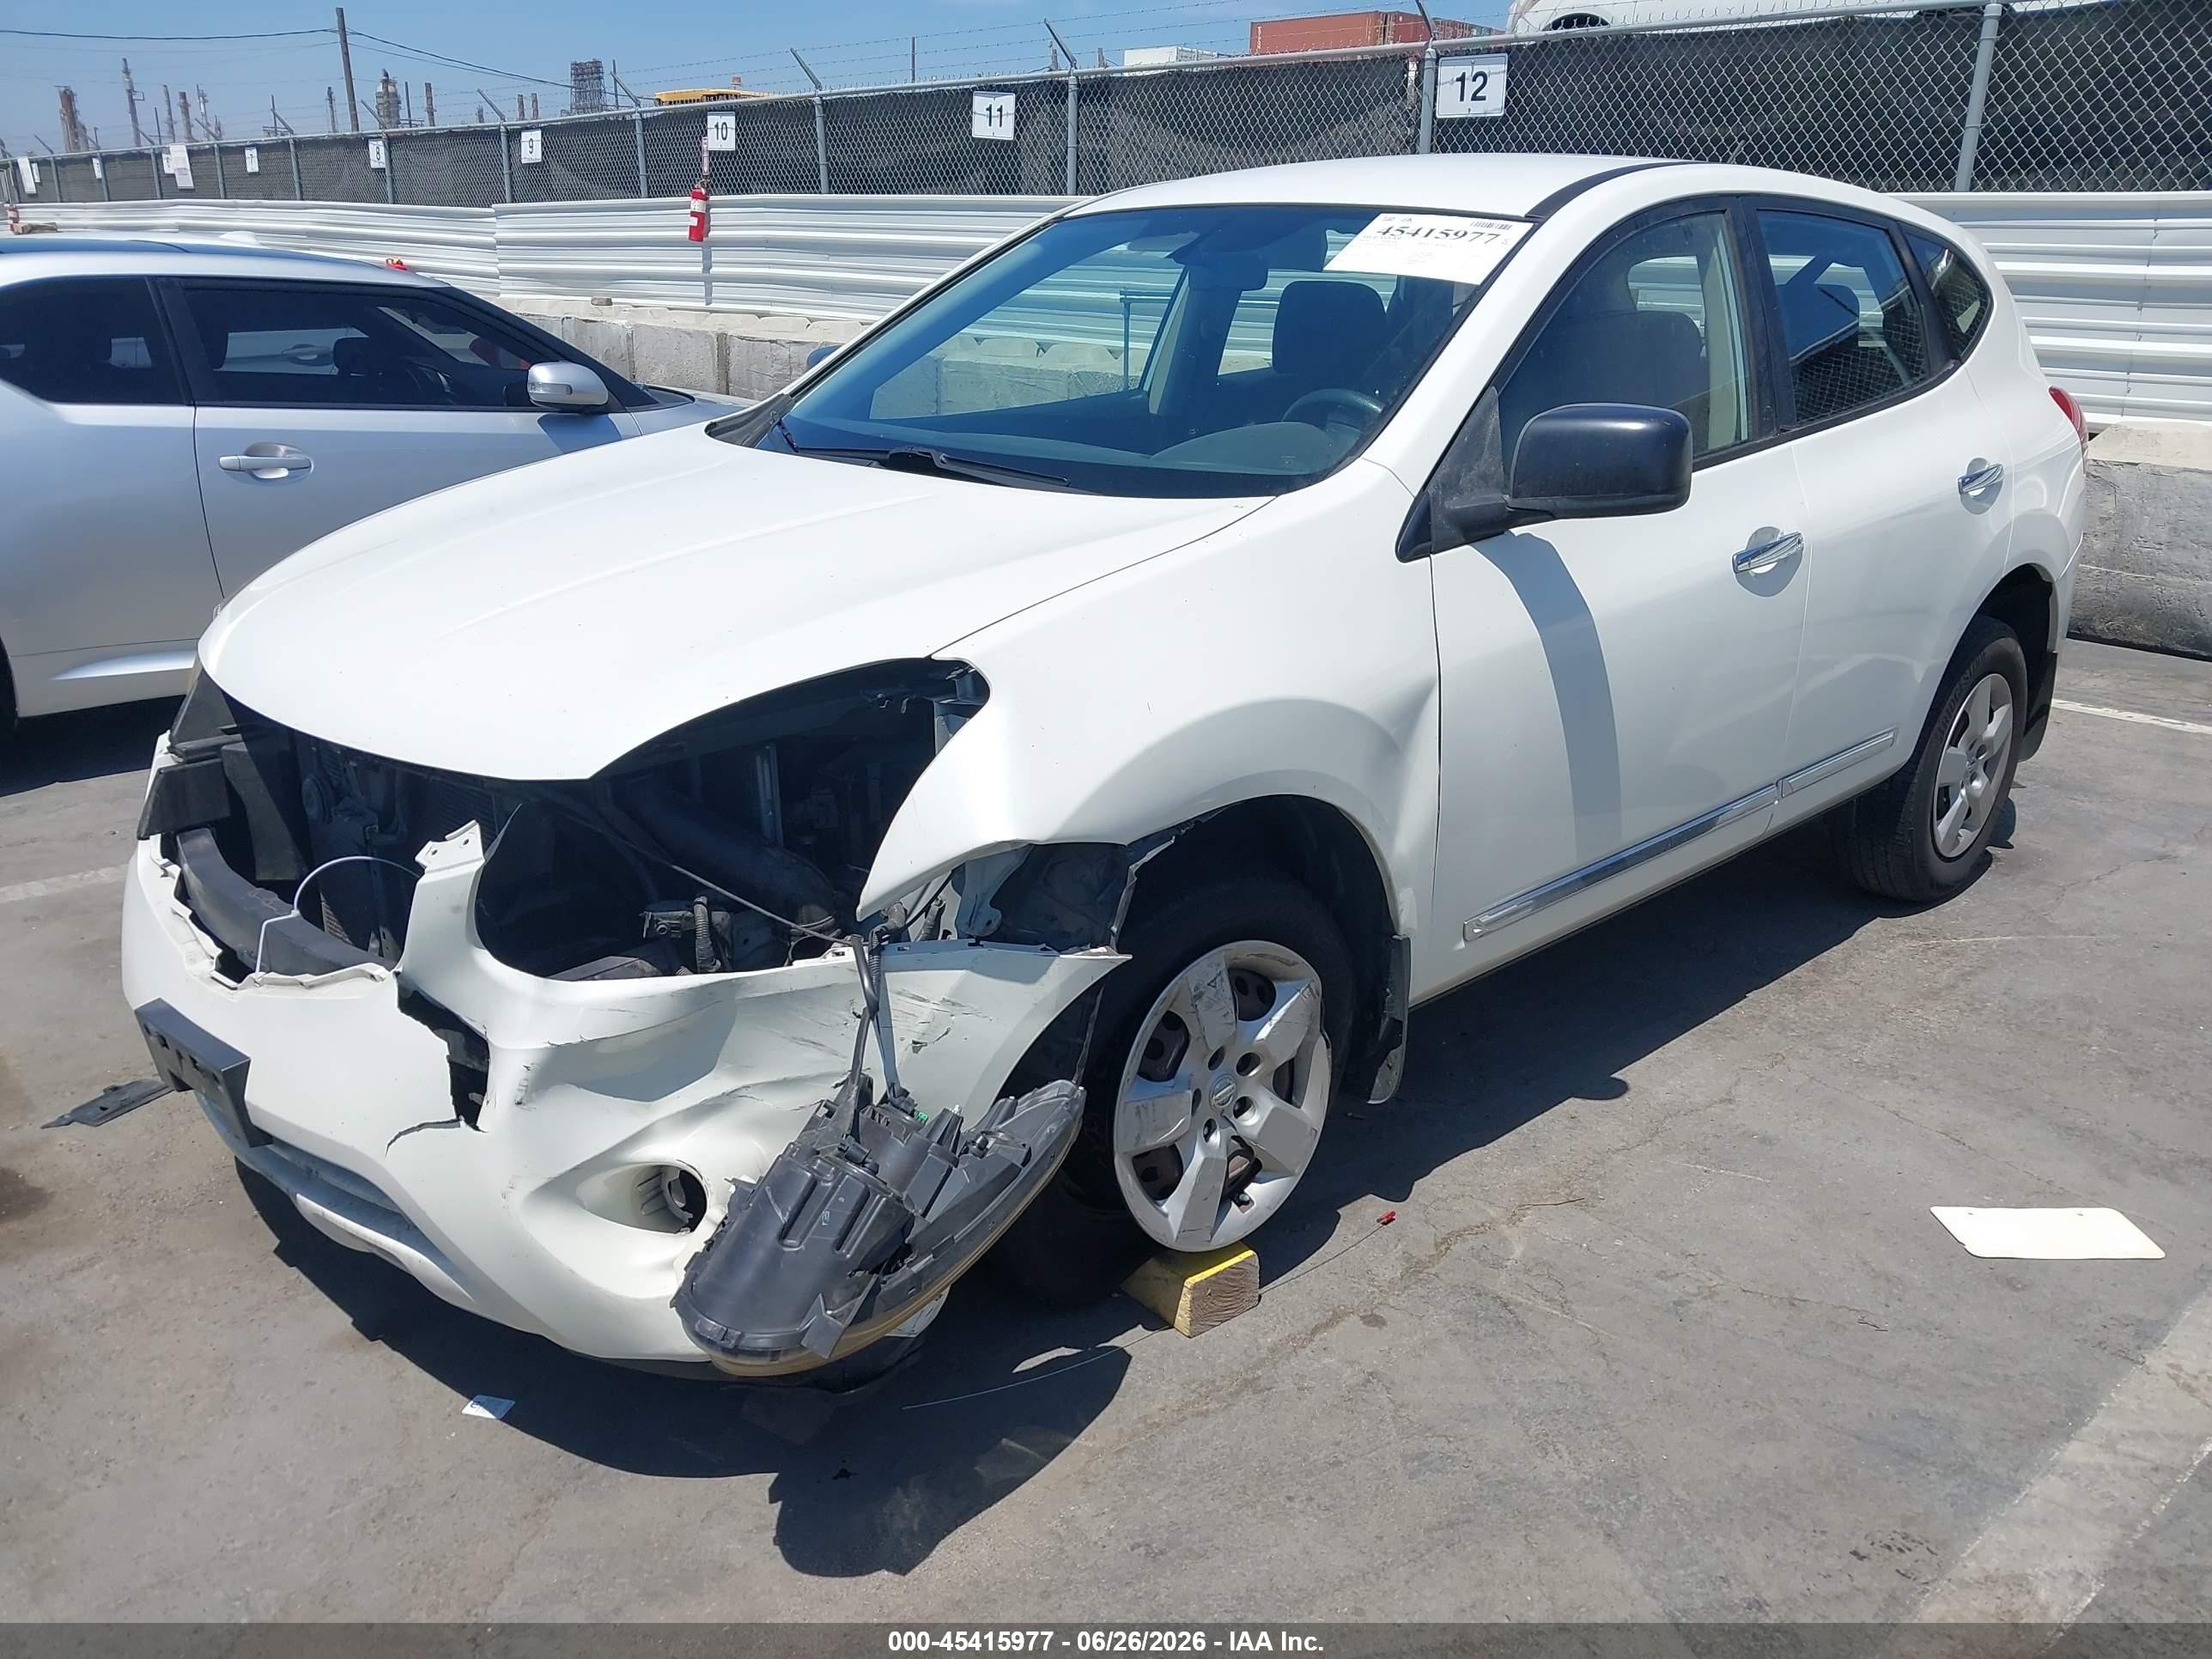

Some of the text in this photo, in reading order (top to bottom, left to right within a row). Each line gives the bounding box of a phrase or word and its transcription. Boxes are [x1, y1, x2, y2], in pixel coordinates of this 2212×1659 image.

[1455, 70, 1488, 102] 12
[985, 103, 1003, 128] 11
[714, 121, 728, 141] 10
[375, 145, 381, 161] 8
[528, 137, 534, 155] 9
[1376, 225, 1502, 245] 45415977
